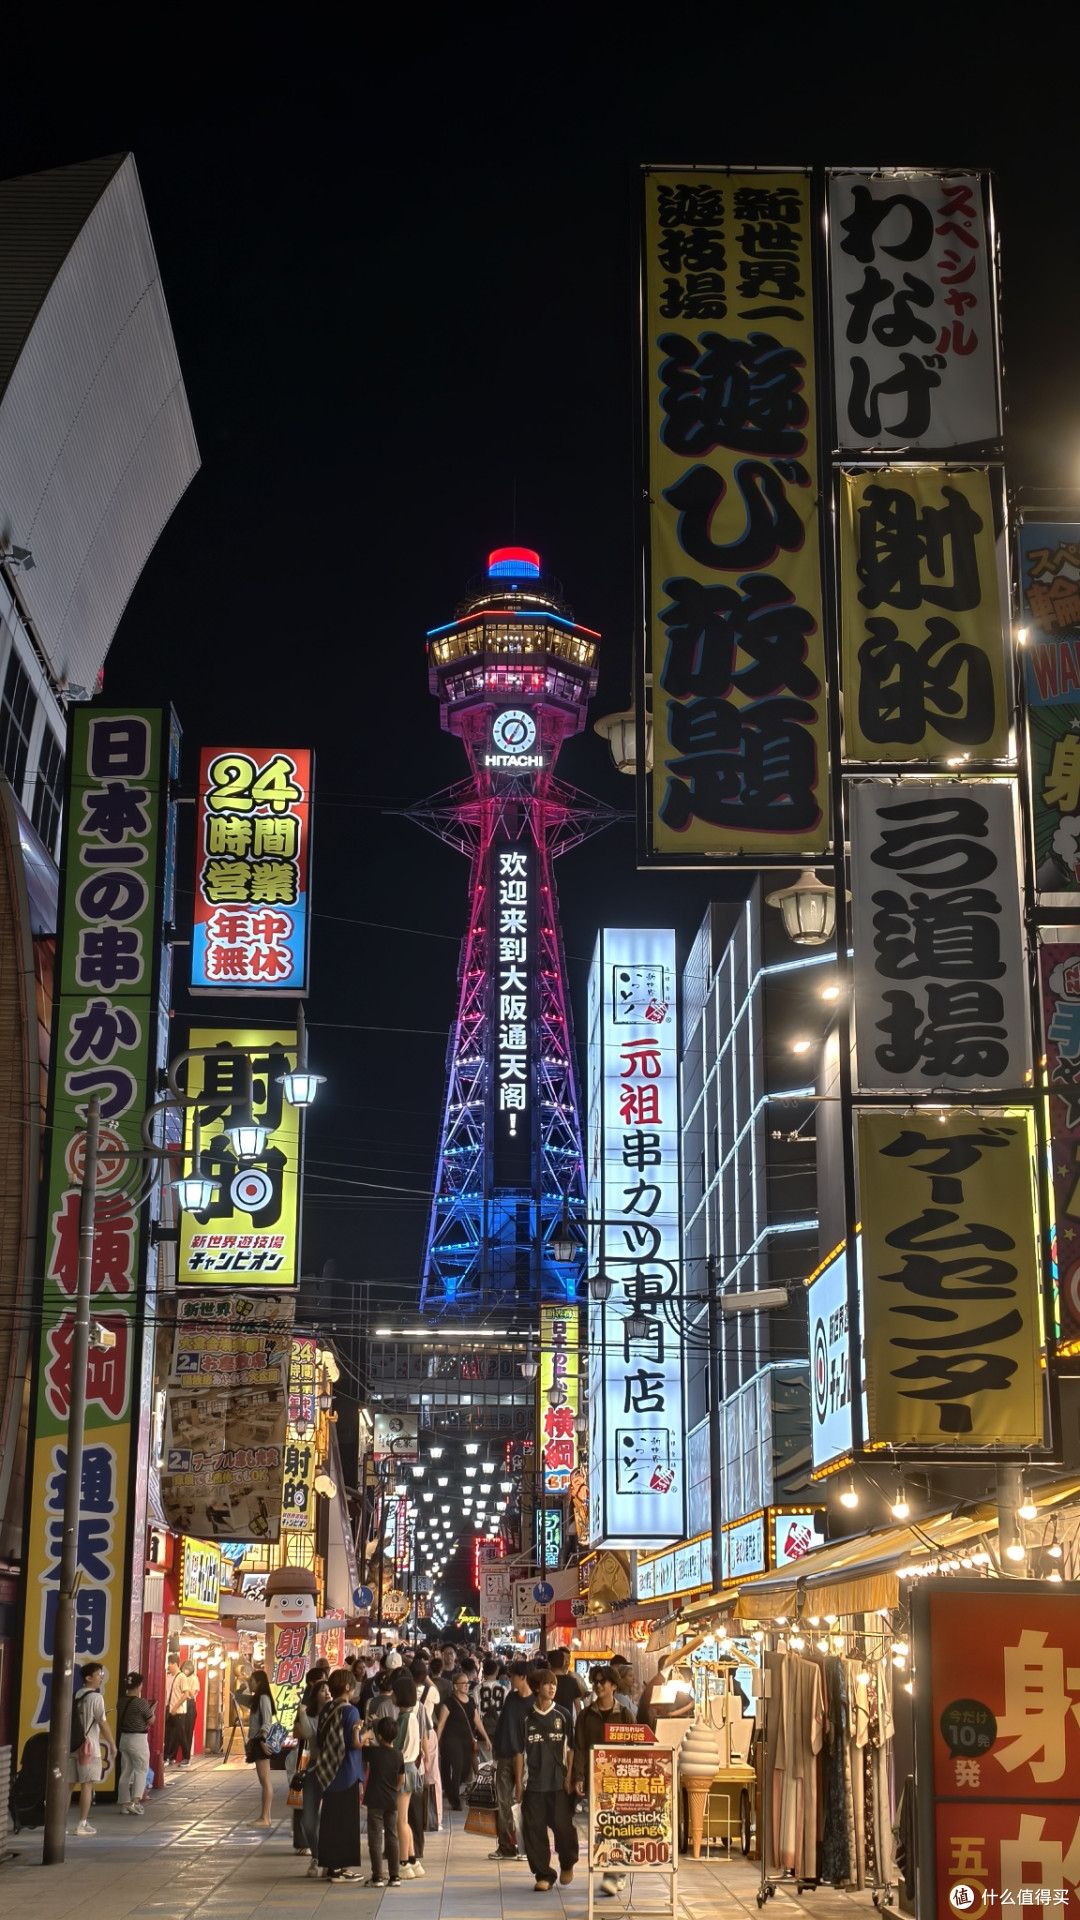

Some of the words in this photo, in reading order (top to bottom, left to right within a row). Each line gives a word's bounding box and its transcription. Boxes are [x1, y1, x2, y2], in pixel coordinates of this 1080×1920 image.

[656, 184, 726, 320] 遊技場
[734, 186, 804, 321] 新世界一
[936, 184, 979, 357] スペシャル
[839, 185, 948, 440] わなげ
[656, 331, 824, 833] 遊び放題
[856, 485, 996, 746] 射的
[1031, 640, 1080, 699] WA
[485, 755, 543, 767] HITACHI
[210, 756, 302, 812] 24
[207, 815, 296, 857] 時間
[206, 859, 295, 905] 営業
[66, 715, 151, 1120] 日本一の串かつ
[209, 912, 290, 942] 年中
[870, 797, 1011, 1078] 弓道場
[208, 945, 290, 980] 無休
[187, 1251, 284, 1273] チャンピオン
[191, 1235, 285, 1250] 新世界遊技場
[877, 1127, 1023, 1433] ゲームセンター
[48, 1192, 138, 1420] 横綱
[183, 1302, 231, 1317] 新世界
[544, 1408, 575, 1471] 横綱
[284, 1445, 312, 1513] 射的
[610, 1732, 645, 1741] おまけ付き
[949, 1710, 988, 1724] 今だけ
[949, 1725, 990, 1748] 10発
[603, 1777, 666, 1794] 豪華賞品
[616, 1764, 651, 1777] お箸で
[954, 1760, 981, 1787] 発
[598, 1811, 667, 1827] Chopsticks
[602, 1824, 667, 1838] Challenge
[633, 1841, 669, 1863] 500
